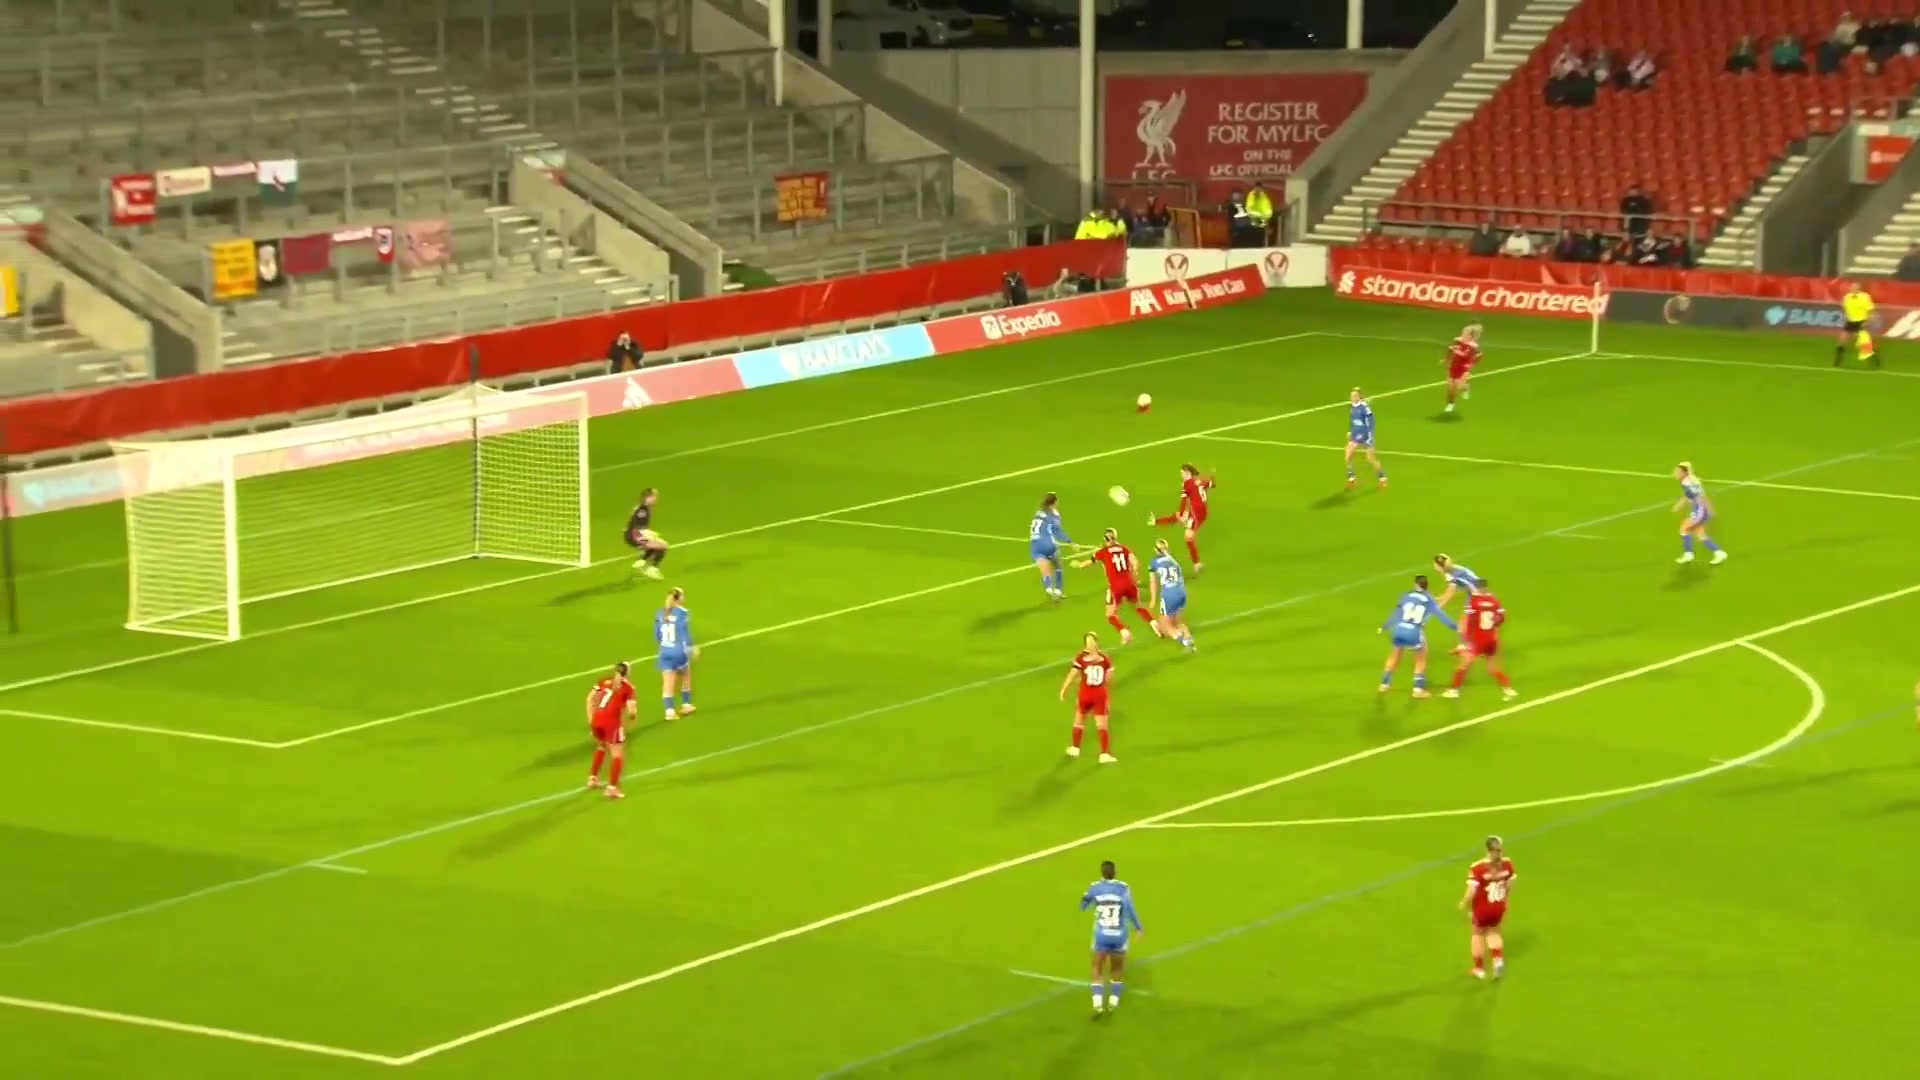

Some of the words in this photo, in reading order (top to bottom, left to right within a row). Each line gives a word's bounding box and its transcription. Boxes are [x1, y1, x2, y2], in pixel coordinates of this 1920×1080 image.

[1218, 102, 1319, 122] REGISTER
[1207, 124, 1250, 144] FOR
[1255, 123, 1329, 143] MYLFC
[1243, 149, 1263, 162] ON
[1267, 149, 1292, 160] THE
[1209, 163, 1234, 177] LFC
[1237, 163, 1293, 176] OFFICIAL
[1129, 288, 1162, 316] AXA
[1201, 282, 1227, 299] You
[1222, 278, 1247, 295] Can
[1360, 274, 1480, 306] standard
[1480, 289, 1610, 315] chartered
[998, 308, 1062, 337] Expedia
[799, 334, 891, 371] BARCLAYS
[1111, 553, 1129, 572] 11
[1157, 566, 1179, 585] 25
[1402, 601, 1426, 624] 14
